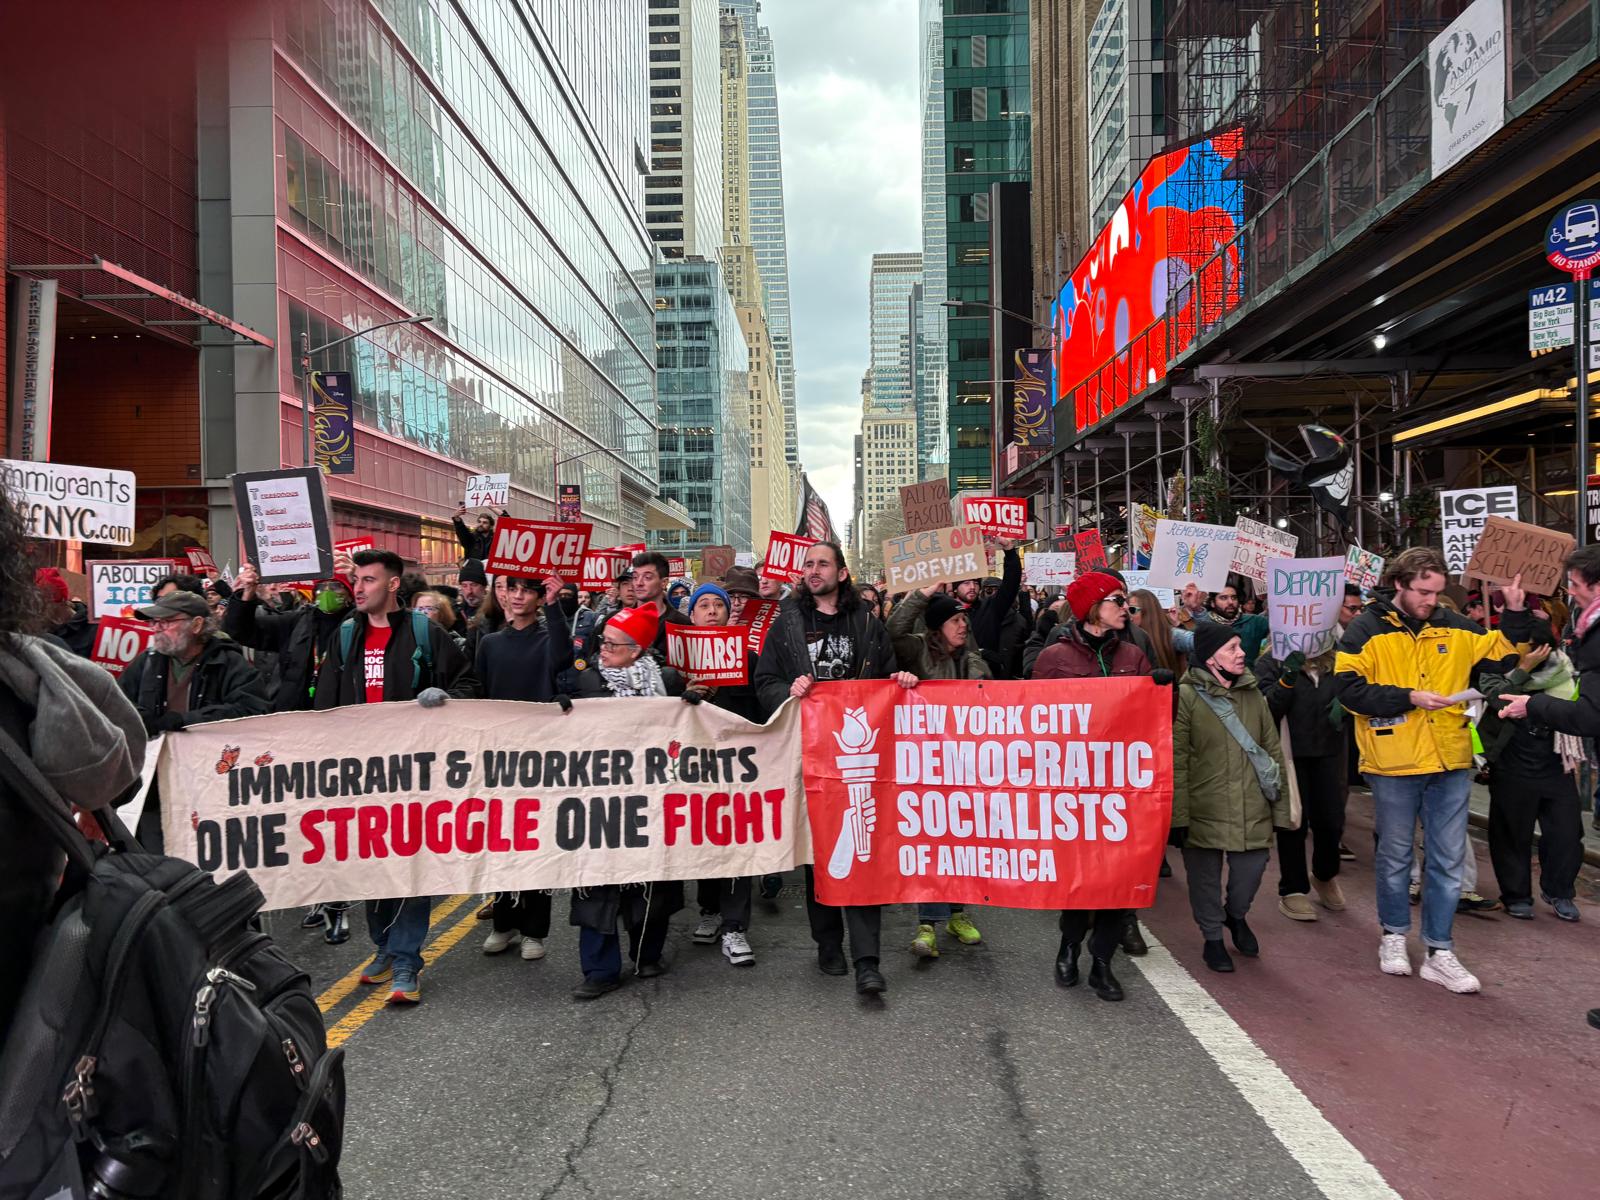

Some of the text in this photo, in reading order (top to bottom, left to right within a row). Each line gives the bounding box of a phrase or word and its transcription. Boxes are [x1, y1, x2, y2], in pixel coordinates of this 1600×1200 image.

[1552, 254, 1566, 267] NO
[1532, 287, 1567, 307] M42
[1533, 317, 1560, 329] New York
[1544, 309, 1556, 318] Bus
[3, 468, 130, 503] mmigrants
[471, 490, 508, 506] 4 ALL
[966, 503, 1024, 527] NO ICE!
[1444, 491, 1515, 516] ICE
[889, 527, 982, 563] ICE OUT
[1167, 522, 1213, 540] REMEMBER
[1483, 524, 1568, 563] PRIMARY
[494, 528, 586, 566] NO ICE!
[768, 540, 792, 568] NO
[96, 565, 168, 584] ABOLISH
[491, 561, 520, 571] HANDS
[521, 565, 538, 573] OFF
[583, 557, 604, 579] NO
[890, 552, 978, 587] FOREVER
[1029, 556, 1052, 568] ICE
[1468, 550, 1558, 587] SCHUMER
[103, 586, 154, 605] ICE
[1274, 568, 1344, 597] DEPORT
[1276, 602, 1323, 626] THE
[746, 602, 773, 656] RESOLUT
[97, 625, 140, 663] NO
[667, 633, 744, 670] NO WARS!
[716, 671, 744, 679] AMERICA
[893, 704, 1092, 736] NEW YORK CITY
[228, 751, 436, 806] IMMIGRANT
[446, 750, 472, 789] &
[483, 749, 634, 788] WORKER
[895, 740, 1154, 788] DEMOCRATIC
[197, 787, 785, 873] ONE STRUGGLE ONE FIGHT
[897, 790, 1128, 842] SOCIALISTS
[898, 845, 1057, 882] OF AMERICA
